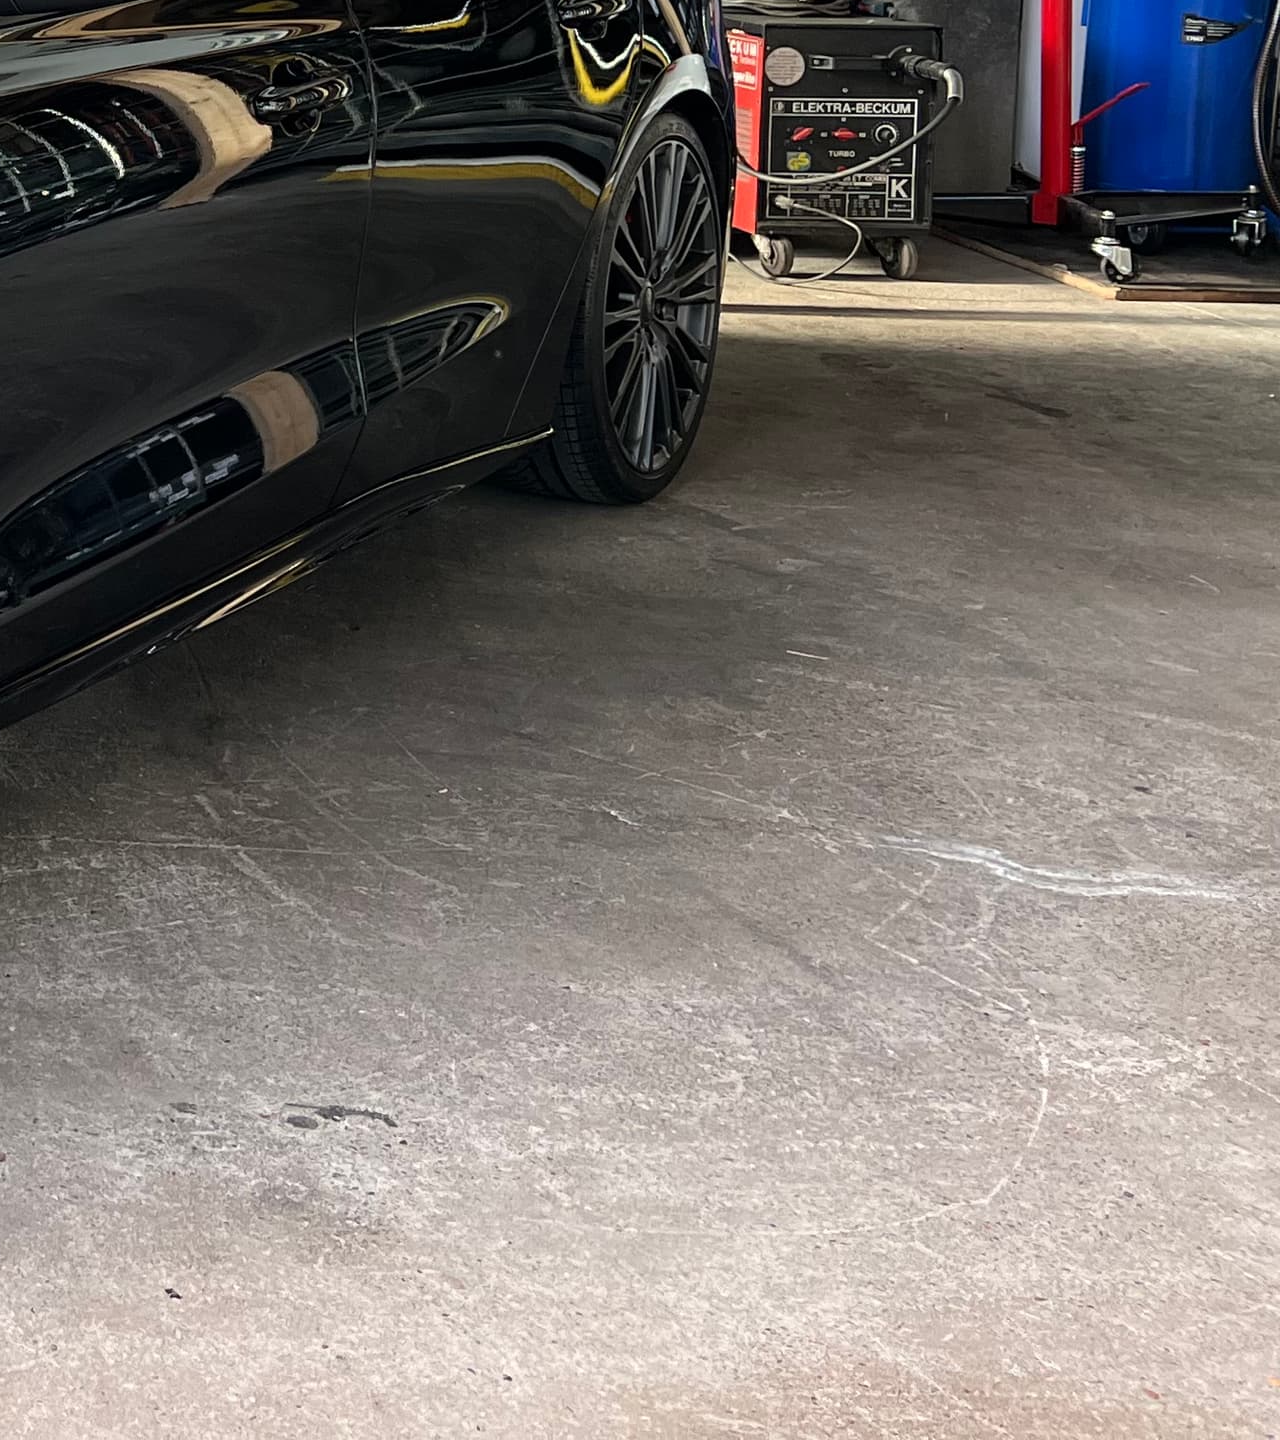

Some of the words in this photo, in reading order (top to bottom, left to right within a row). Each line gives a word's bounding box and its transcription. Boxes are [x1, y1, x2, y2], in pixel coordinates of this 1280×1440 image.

[727, 38, 757, 57] CKUM
[792, 102, 912, 114] ELEKTRA-BECKUM
[828, 150, 856, 158] TURBO
[890, 178, 909, 198] K
